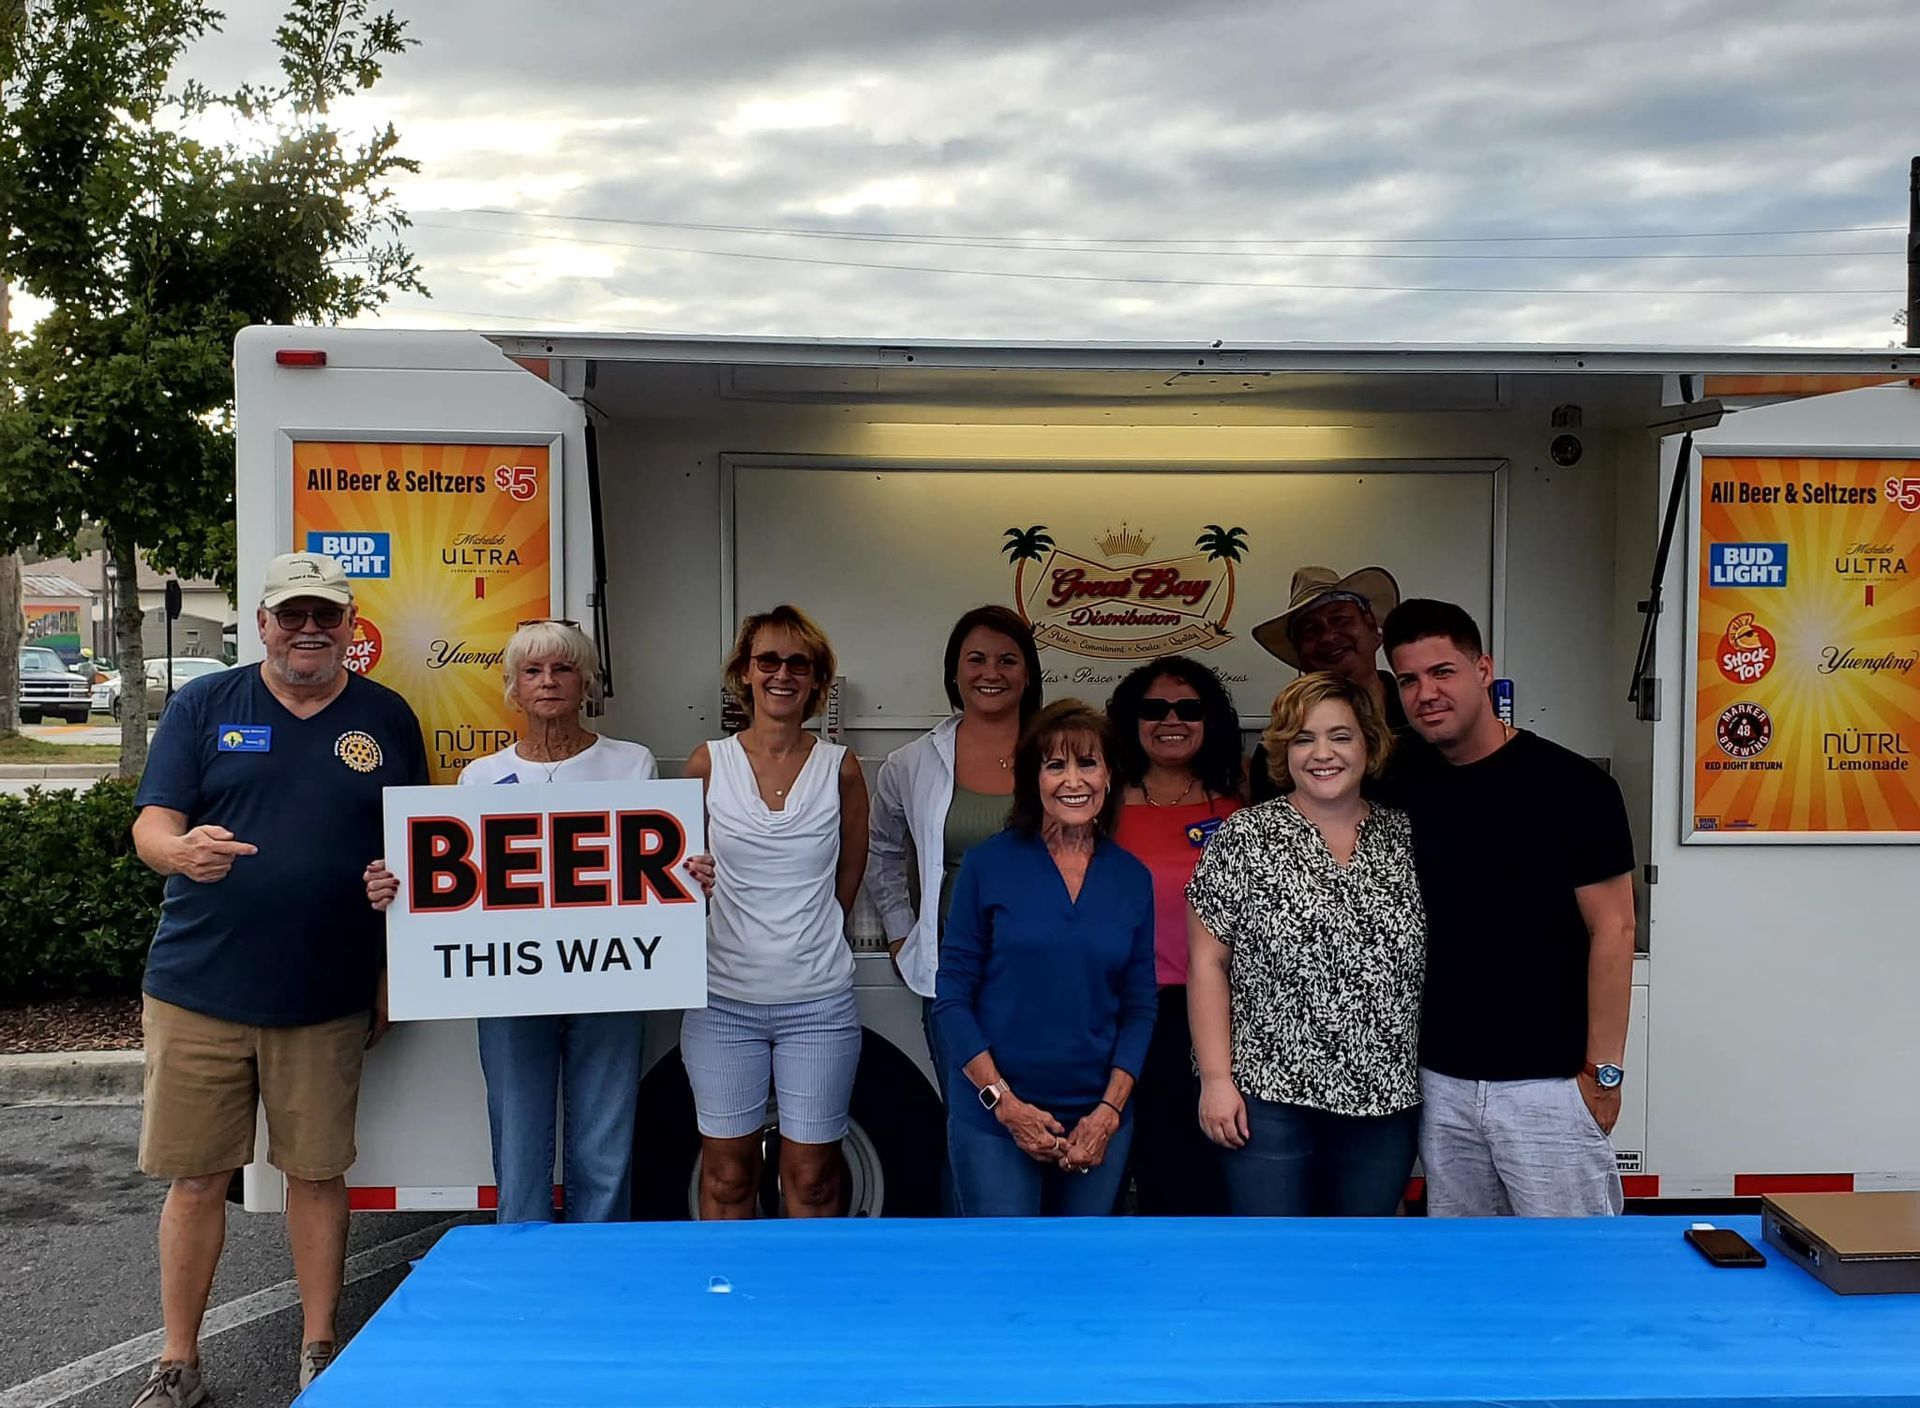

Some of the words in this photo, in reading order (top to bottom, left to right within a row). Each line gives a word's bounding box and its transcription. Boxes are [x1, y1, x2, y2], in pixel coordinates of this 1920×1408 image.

[307, 468, 332, 491] All
[337, 469, 382, 491] Beer
[386, 470, 400, 492] &
[405, 470, 486, 493] Seltzers
[495, 465, 538, 501] $5
[1710, 482, 1734, 503] All
[1739, 483, 1781, 503] Beer
[1785, 483, 1798, 503] &
[1802, 482, 1877, 504] Seltzers
[1884, 476, 1920, 512] $5
[322, 536, 375, 555] BUD
[453, 533, 506, 545] Michelob
[442, 548, 520, 565] ULTRA
[1723, 548, 1774, 565] BUD
[1835, 558, 1907, 573] ULTRA
[1713, 565, 1782, 583] LIGHT
[1047, 568, 1133, 607] Great
[1132, 567, 1212, 605] Bay
[1067, 608, 1181, 626] Distributors
[346, 641, 377, 656] OCK
[1723, 647, 1771, 671] SHOCK
[1817, 646, 1919, 675] Yuengling
[1073, 667, 1113, 683] Pasco
[1734, 661, 1765, 681] TOP
[828, 683, 839, 725] ULTRA
[1722, 704, 1767, 722] MARKER
[1737, 724, 1751, 736] 48
[1720, 735, 1768, 756] BREWING
[1705, 761, 1720, 770] RED
[1723, 761, 1748, 770] RIGHT
[1750, 761, 1783, 770] RETURN
[1828, 757, 1908, 771] Lemonade
[407, 809, 697, 913] BEER
[434, 940, 543, 978] THIS
[556, 936, 662, 974] WAY
